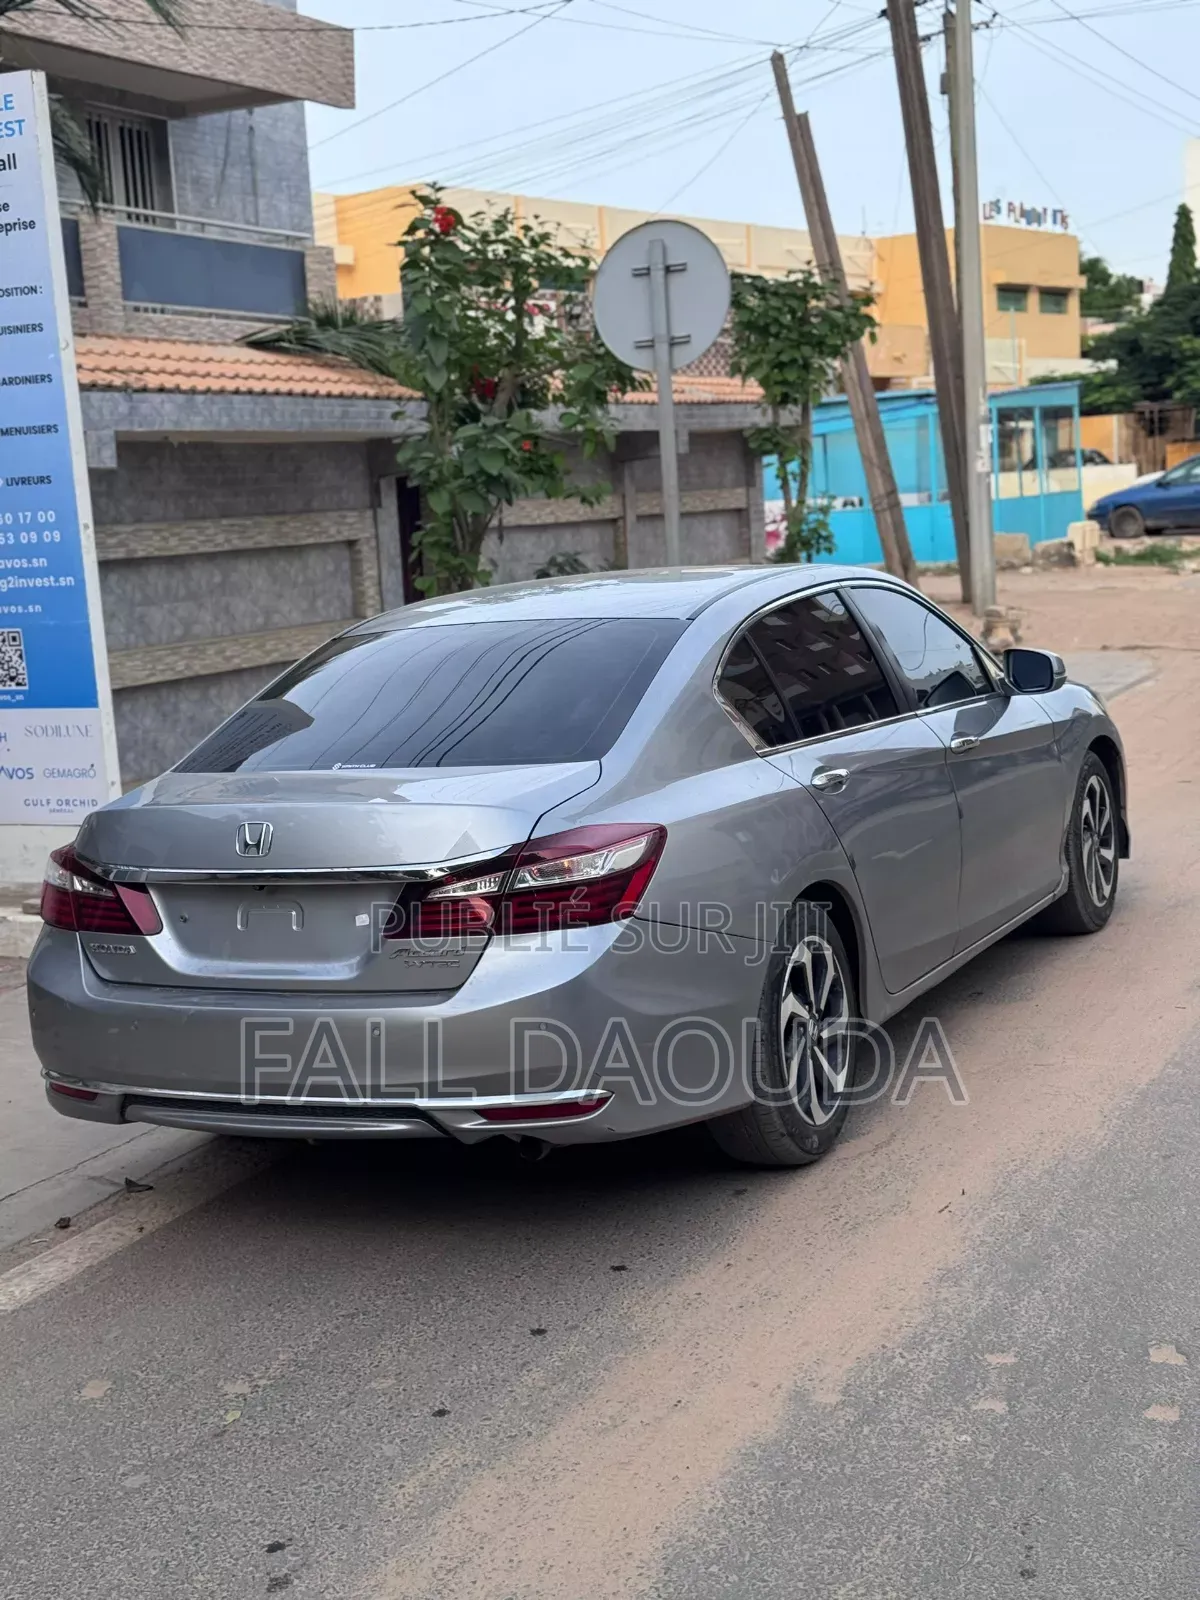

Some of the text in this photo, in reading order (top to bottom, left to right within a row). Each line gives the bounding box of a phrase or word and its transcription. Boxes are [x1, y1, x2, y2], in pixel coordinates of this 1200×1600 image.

[6, 475, 52, 487] LIVREURS
[18, 511, 32, 524] 17
[37, 510, 56, 523] 00
[20, 531, 38, 544] 09
[43, 530, 61, 543] 09
[0, 604, 42, 614] vos.sn
[24, 798, 98, 807] GULF ORCHID
